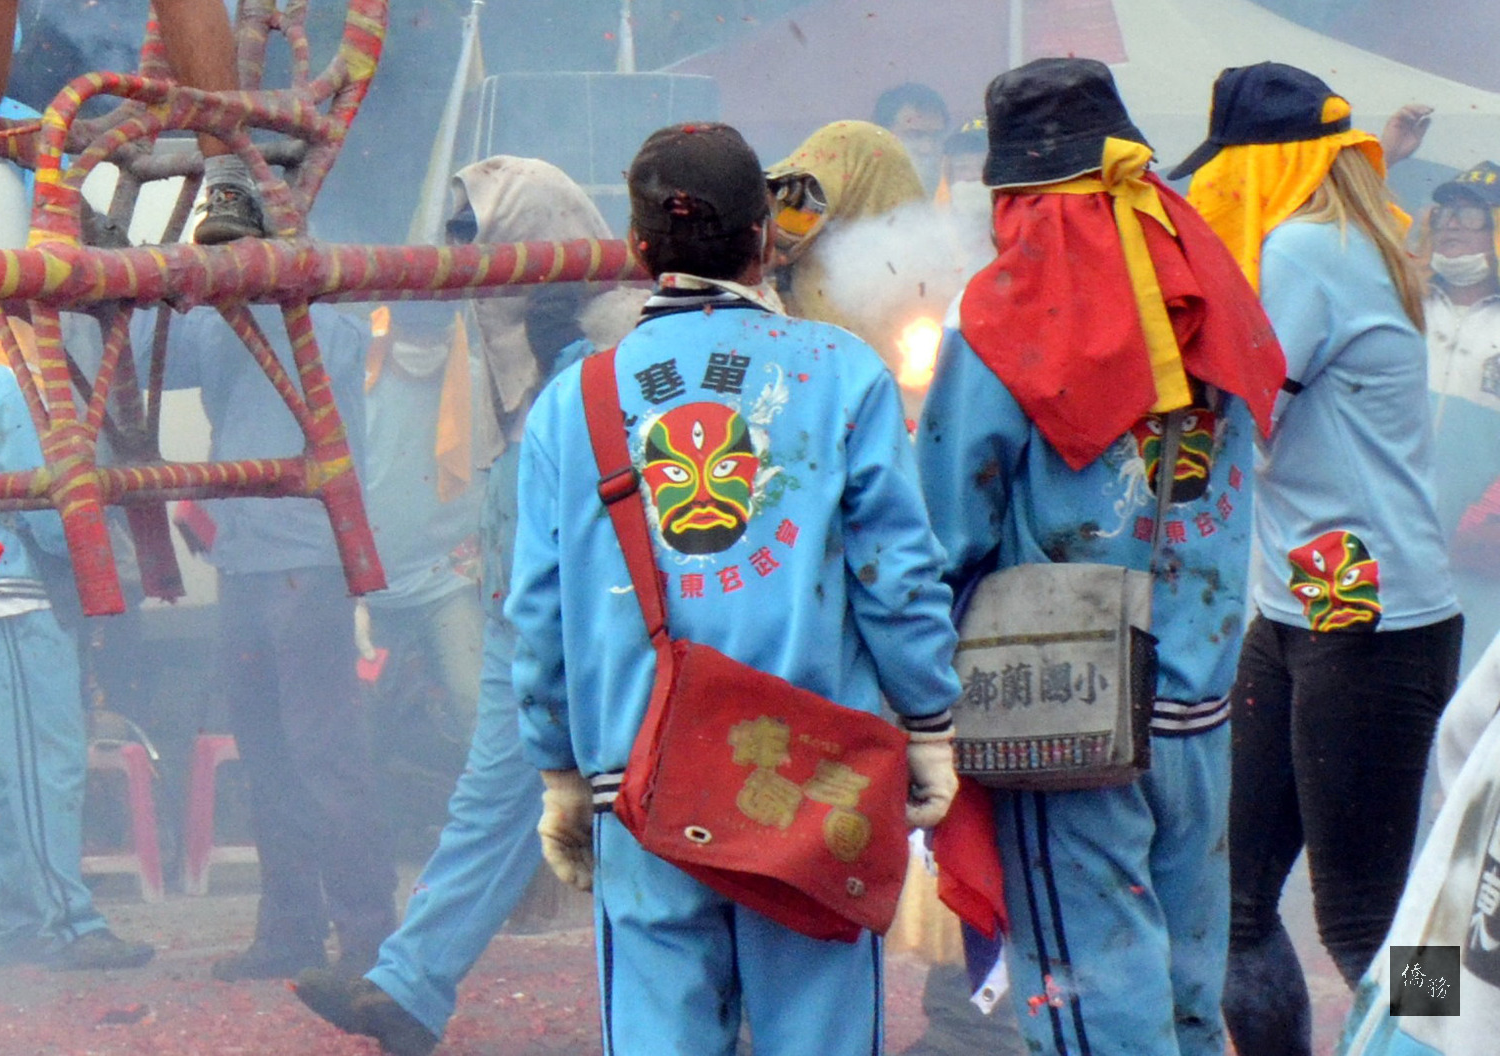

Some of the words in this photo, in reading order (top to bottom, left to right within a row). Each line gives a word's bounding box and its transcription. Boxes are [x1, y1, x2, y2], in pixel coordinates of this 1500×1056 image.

[624, 352, 750, 430] 寒單
[660, 518, 800, 599] 東玄武堂
